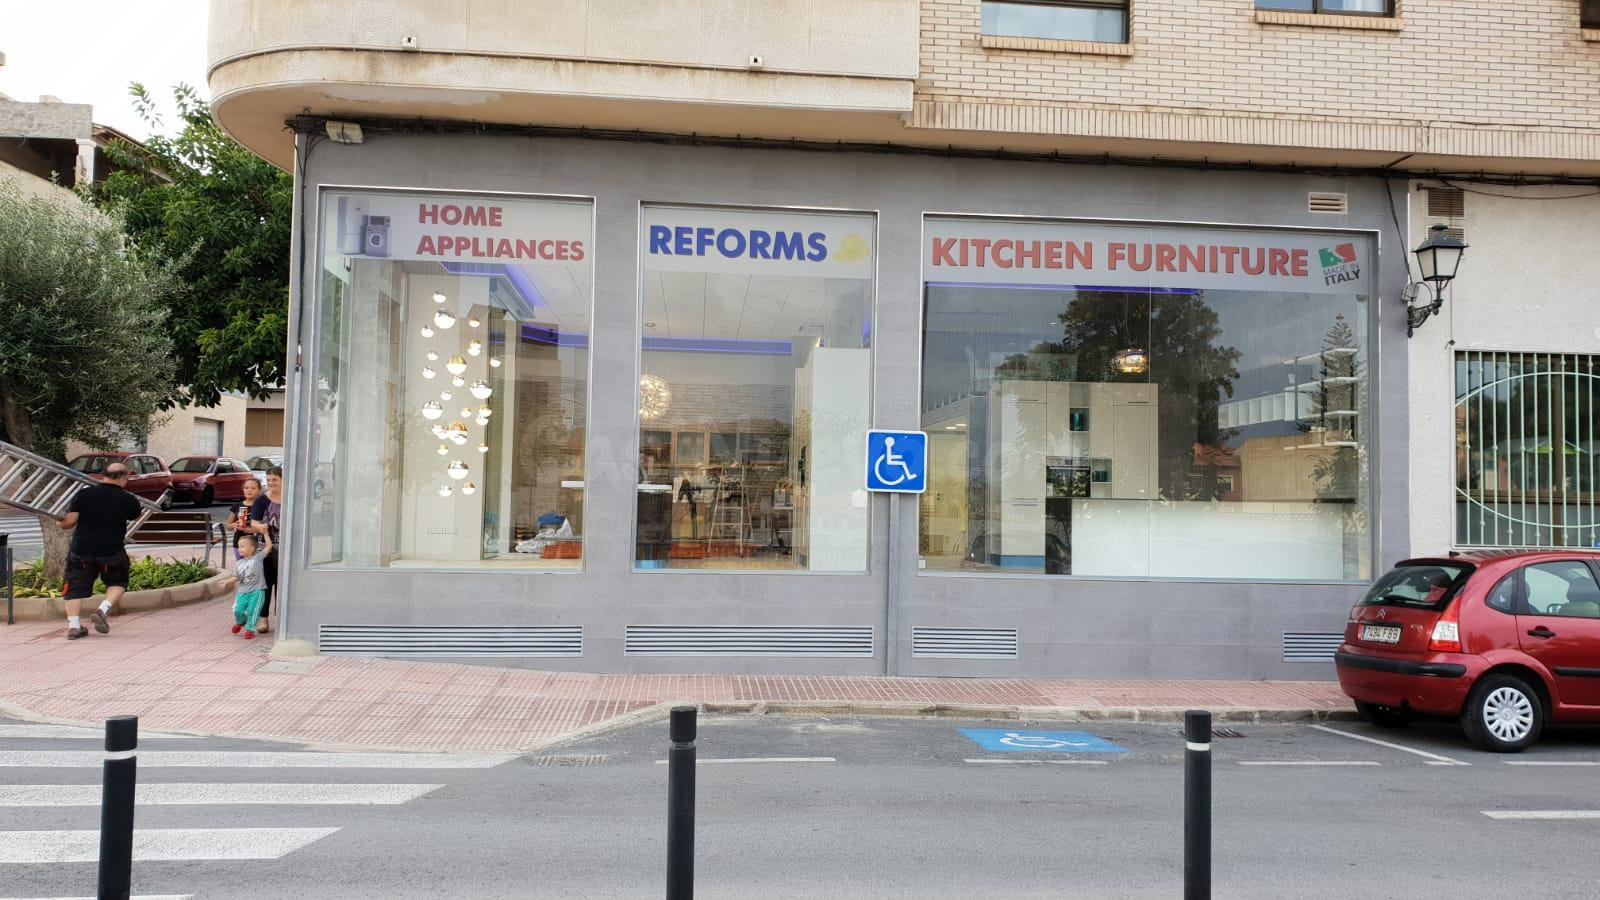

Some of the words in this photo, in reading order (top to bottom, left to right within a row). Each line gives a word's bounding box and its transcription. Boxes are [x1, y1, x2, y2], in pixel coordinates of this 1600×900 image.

[418, 204, 503, 228] HOME
[416, 234, 585, 262] APPLIANCES
[649, 224, 828, 262] REFORMS
[931, 237, 1093, 270] KITCHEN
[1107, 243, 1309, 277] FURNITURE
[1323, 266, 1347, 275] MADE
[1324, 269, 1361, 286] ITALY
